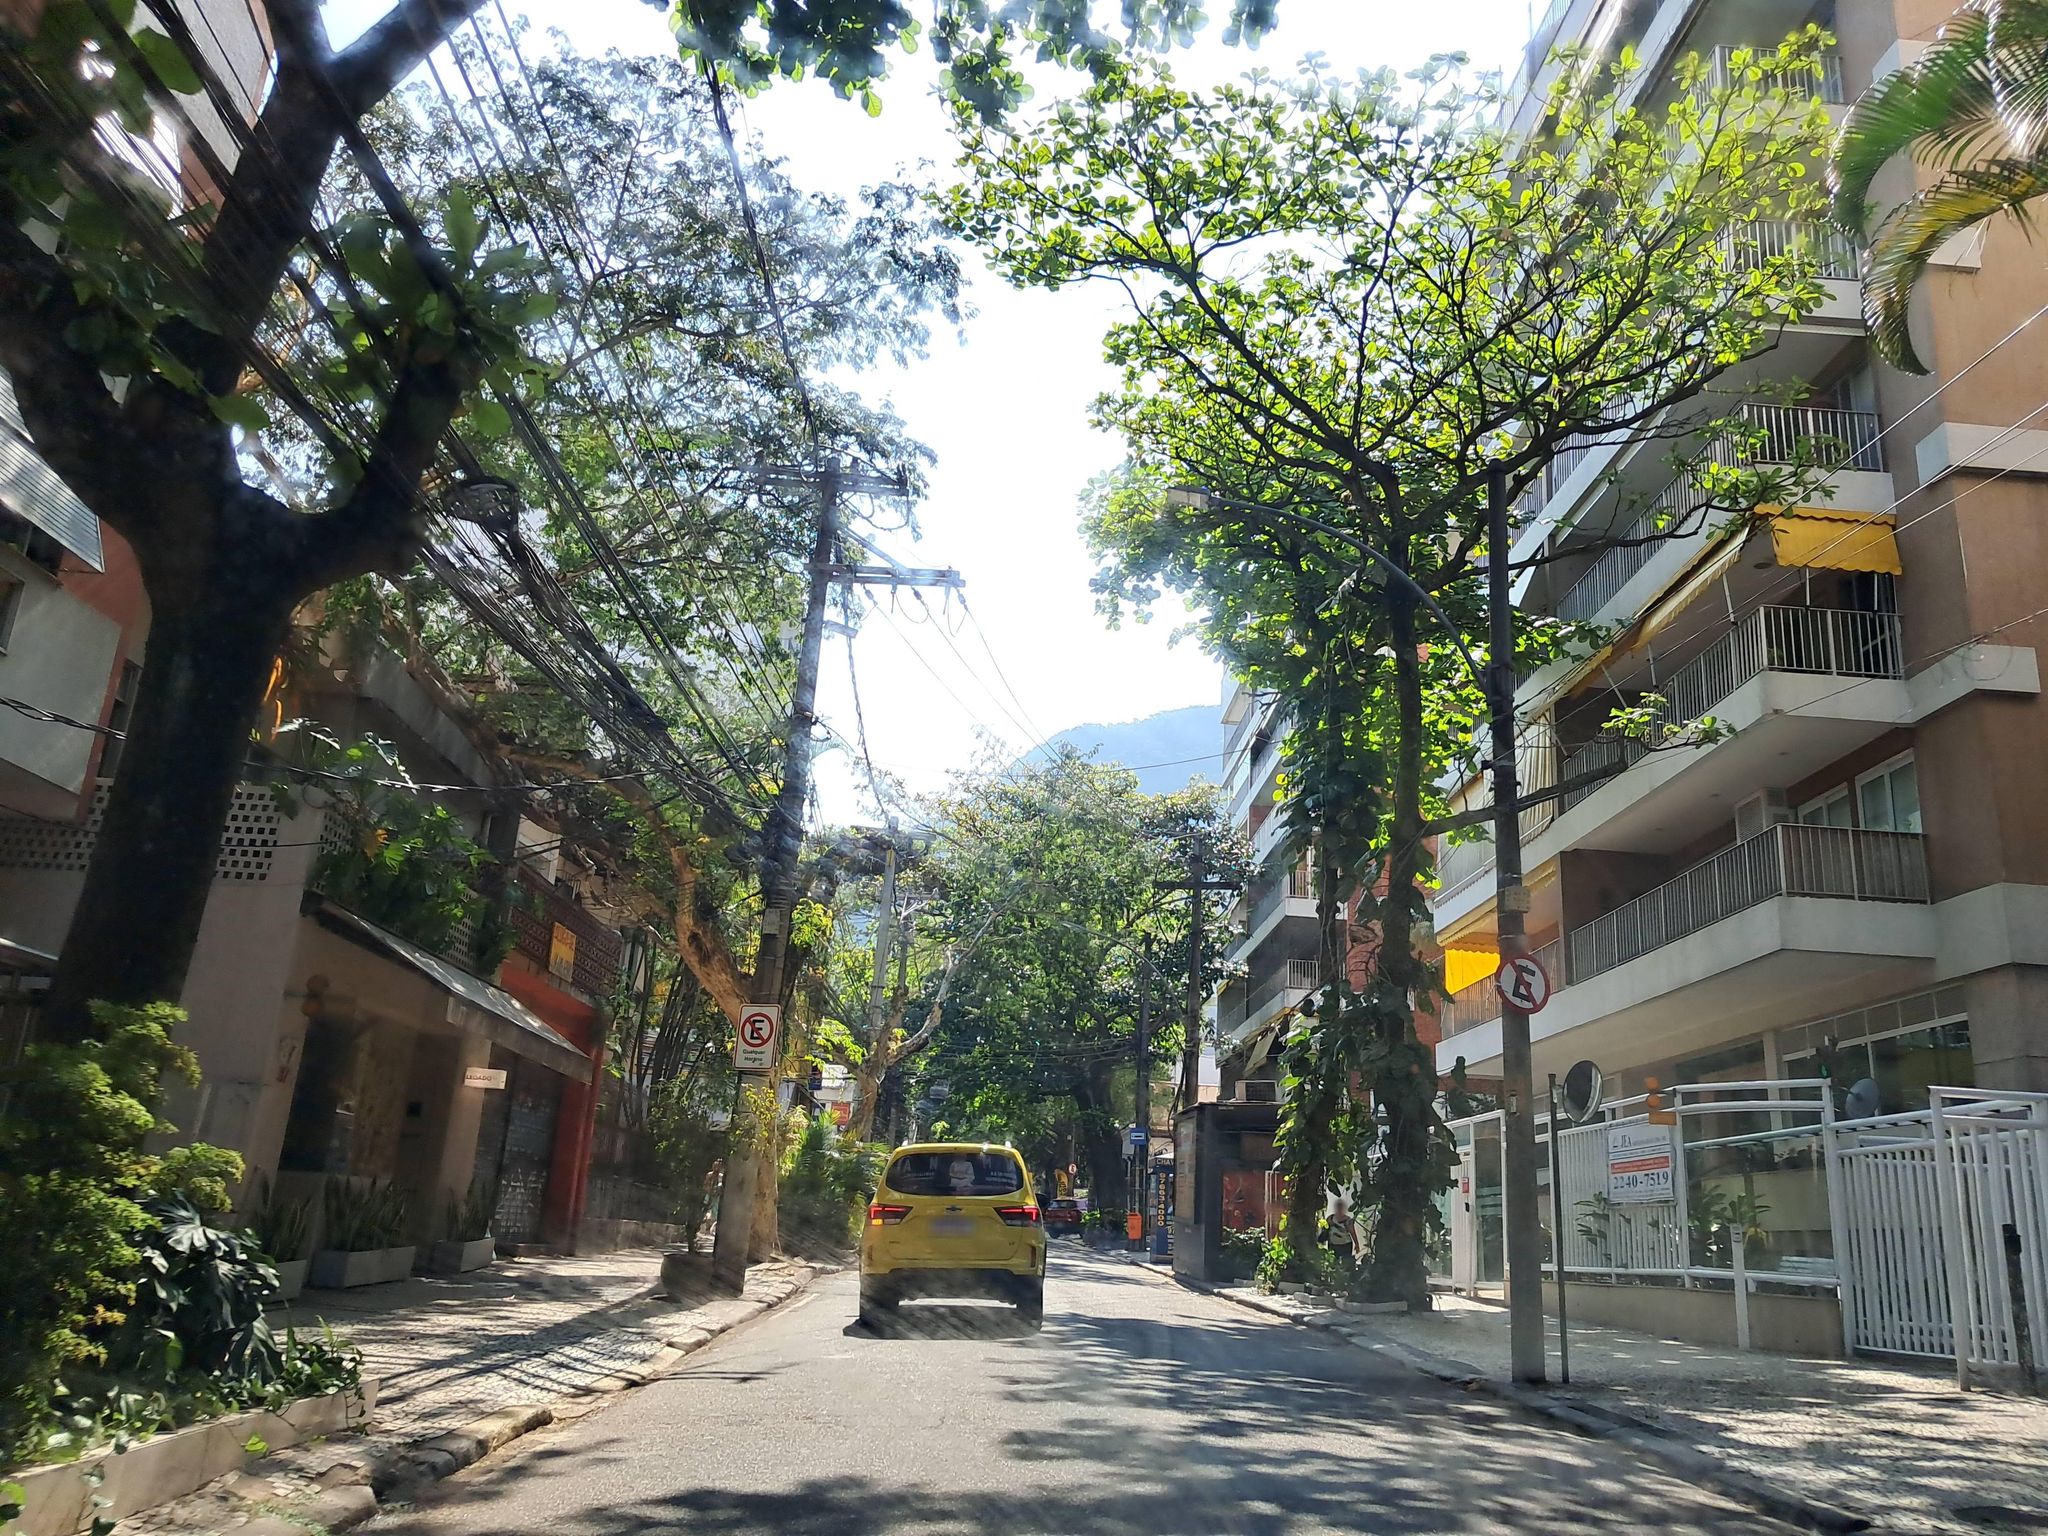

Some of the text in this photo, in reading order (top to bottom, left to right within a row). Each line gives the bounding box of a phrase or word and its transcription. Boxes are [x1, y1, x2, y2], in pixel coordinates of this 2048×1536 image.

[1512, 964, 1536, 1003] E
[750, 1019, 765, 1040] E
[1613, 1171, 1669, 1189] 2240-7519
